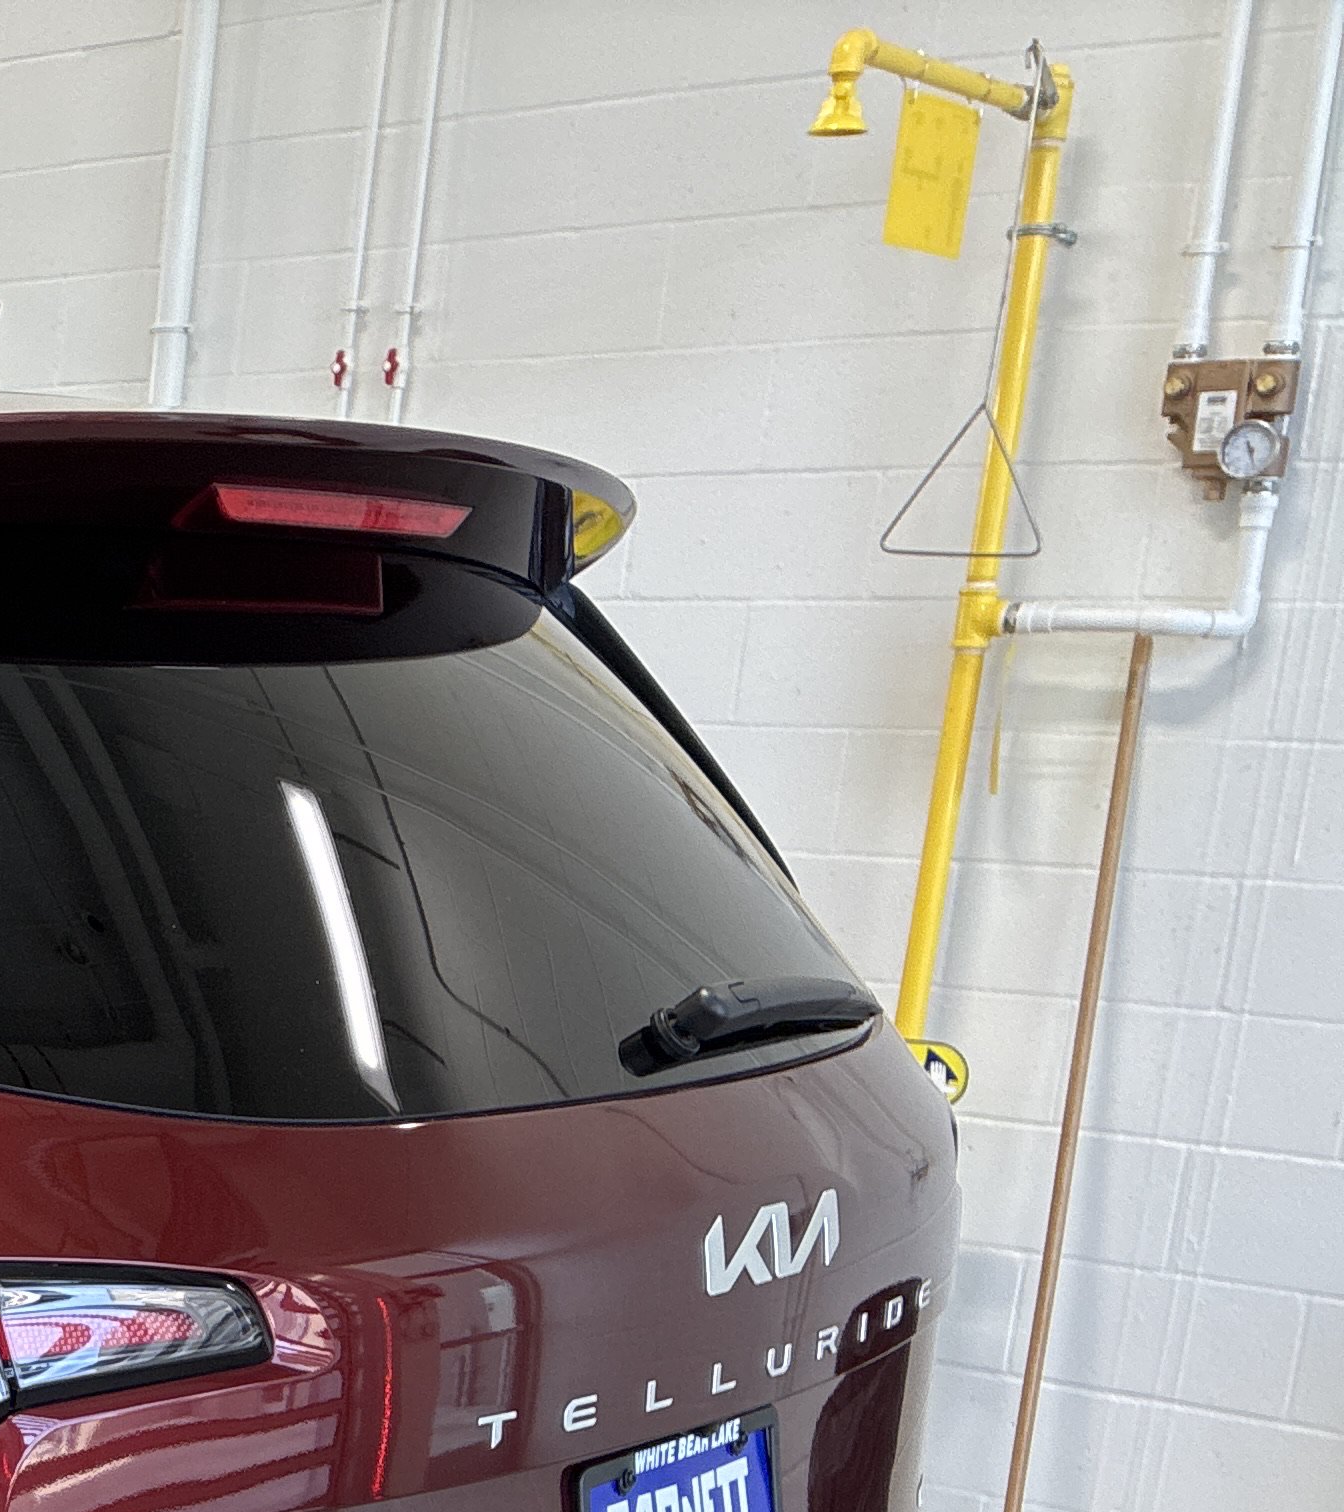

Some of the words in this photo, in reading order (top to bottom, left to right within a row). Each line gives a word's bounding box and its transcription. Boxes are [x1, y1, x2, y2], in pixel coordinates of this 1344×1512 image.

[478, 1279, 933, 1449] TELLURIDE
[634, 1440, 677, 1475] WHITE
[711, 1417, 741, 1449] LAKE
